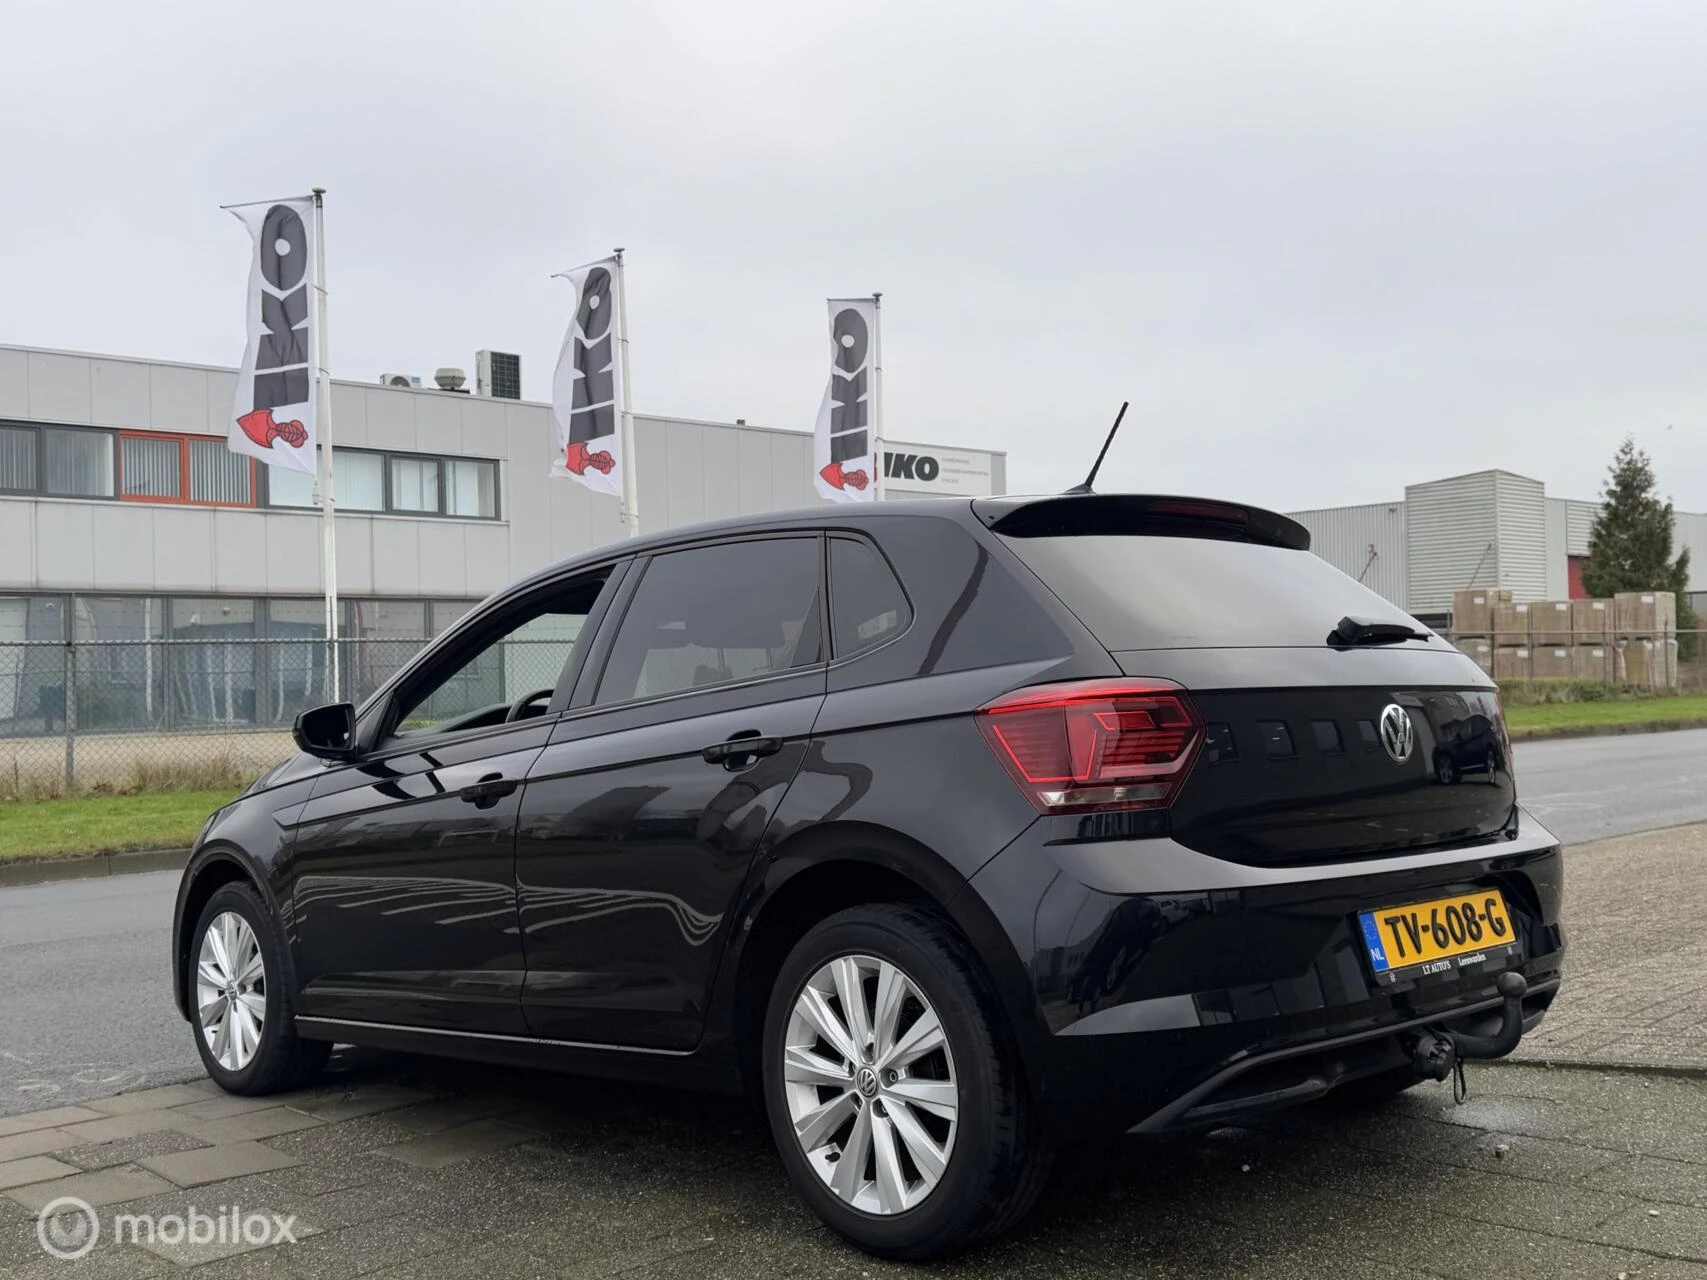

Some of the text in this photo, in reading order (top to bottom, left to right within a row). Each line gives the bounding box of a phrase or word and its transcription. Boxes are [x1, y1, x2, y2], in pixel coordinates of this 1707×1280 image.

[253, 204, 309, 410] IKO
[569, 266, 616, 443] IKO
[830, 308, 869, 464] IKO
[884, 452, 940, 481] IKO
[1370, 948, 1385, 961] NL
[1384, 898, 1507, 958] TV-608-G
